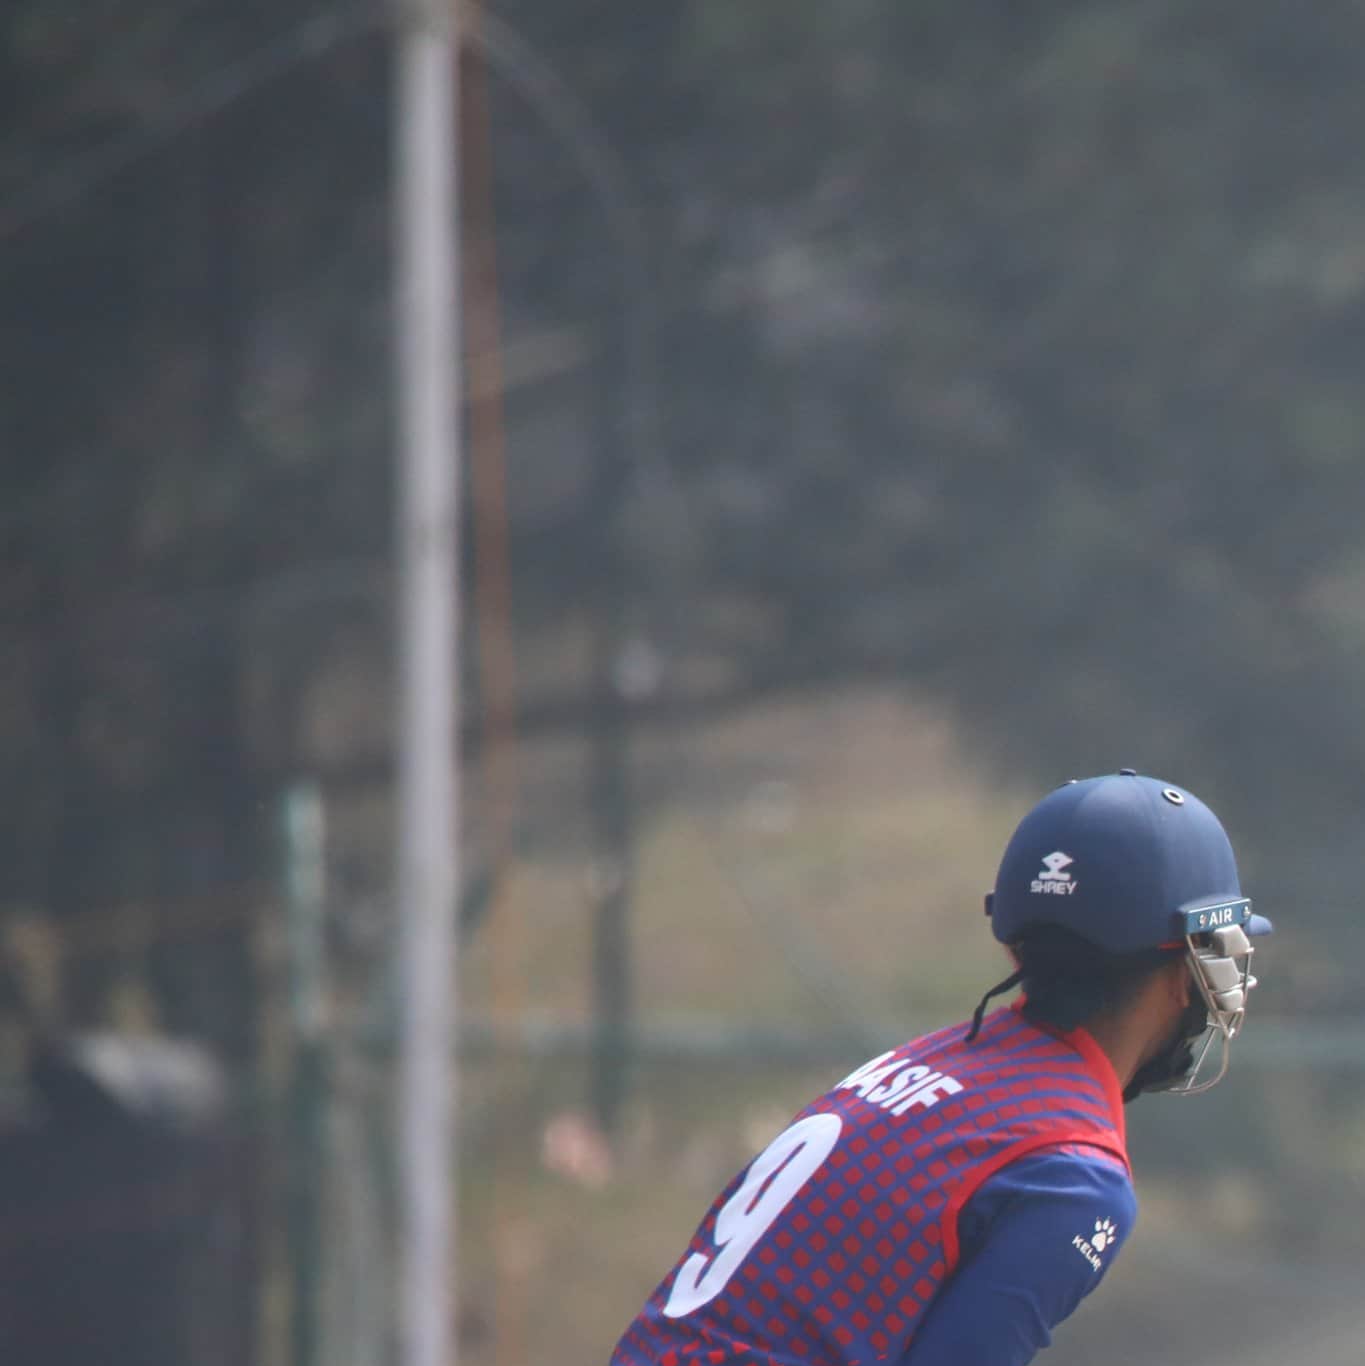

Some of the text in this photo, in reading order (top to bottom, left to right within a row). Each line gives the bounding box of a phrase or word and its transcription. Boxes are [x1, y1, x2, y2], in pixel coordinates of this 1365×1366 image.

[1030, 880, 1077, 895] SHREY
[1209, 908, 1233, 926] AIR
[662, 1113, 843, 1319] 9
[1071, 1234, 1102, 1272] KELM
